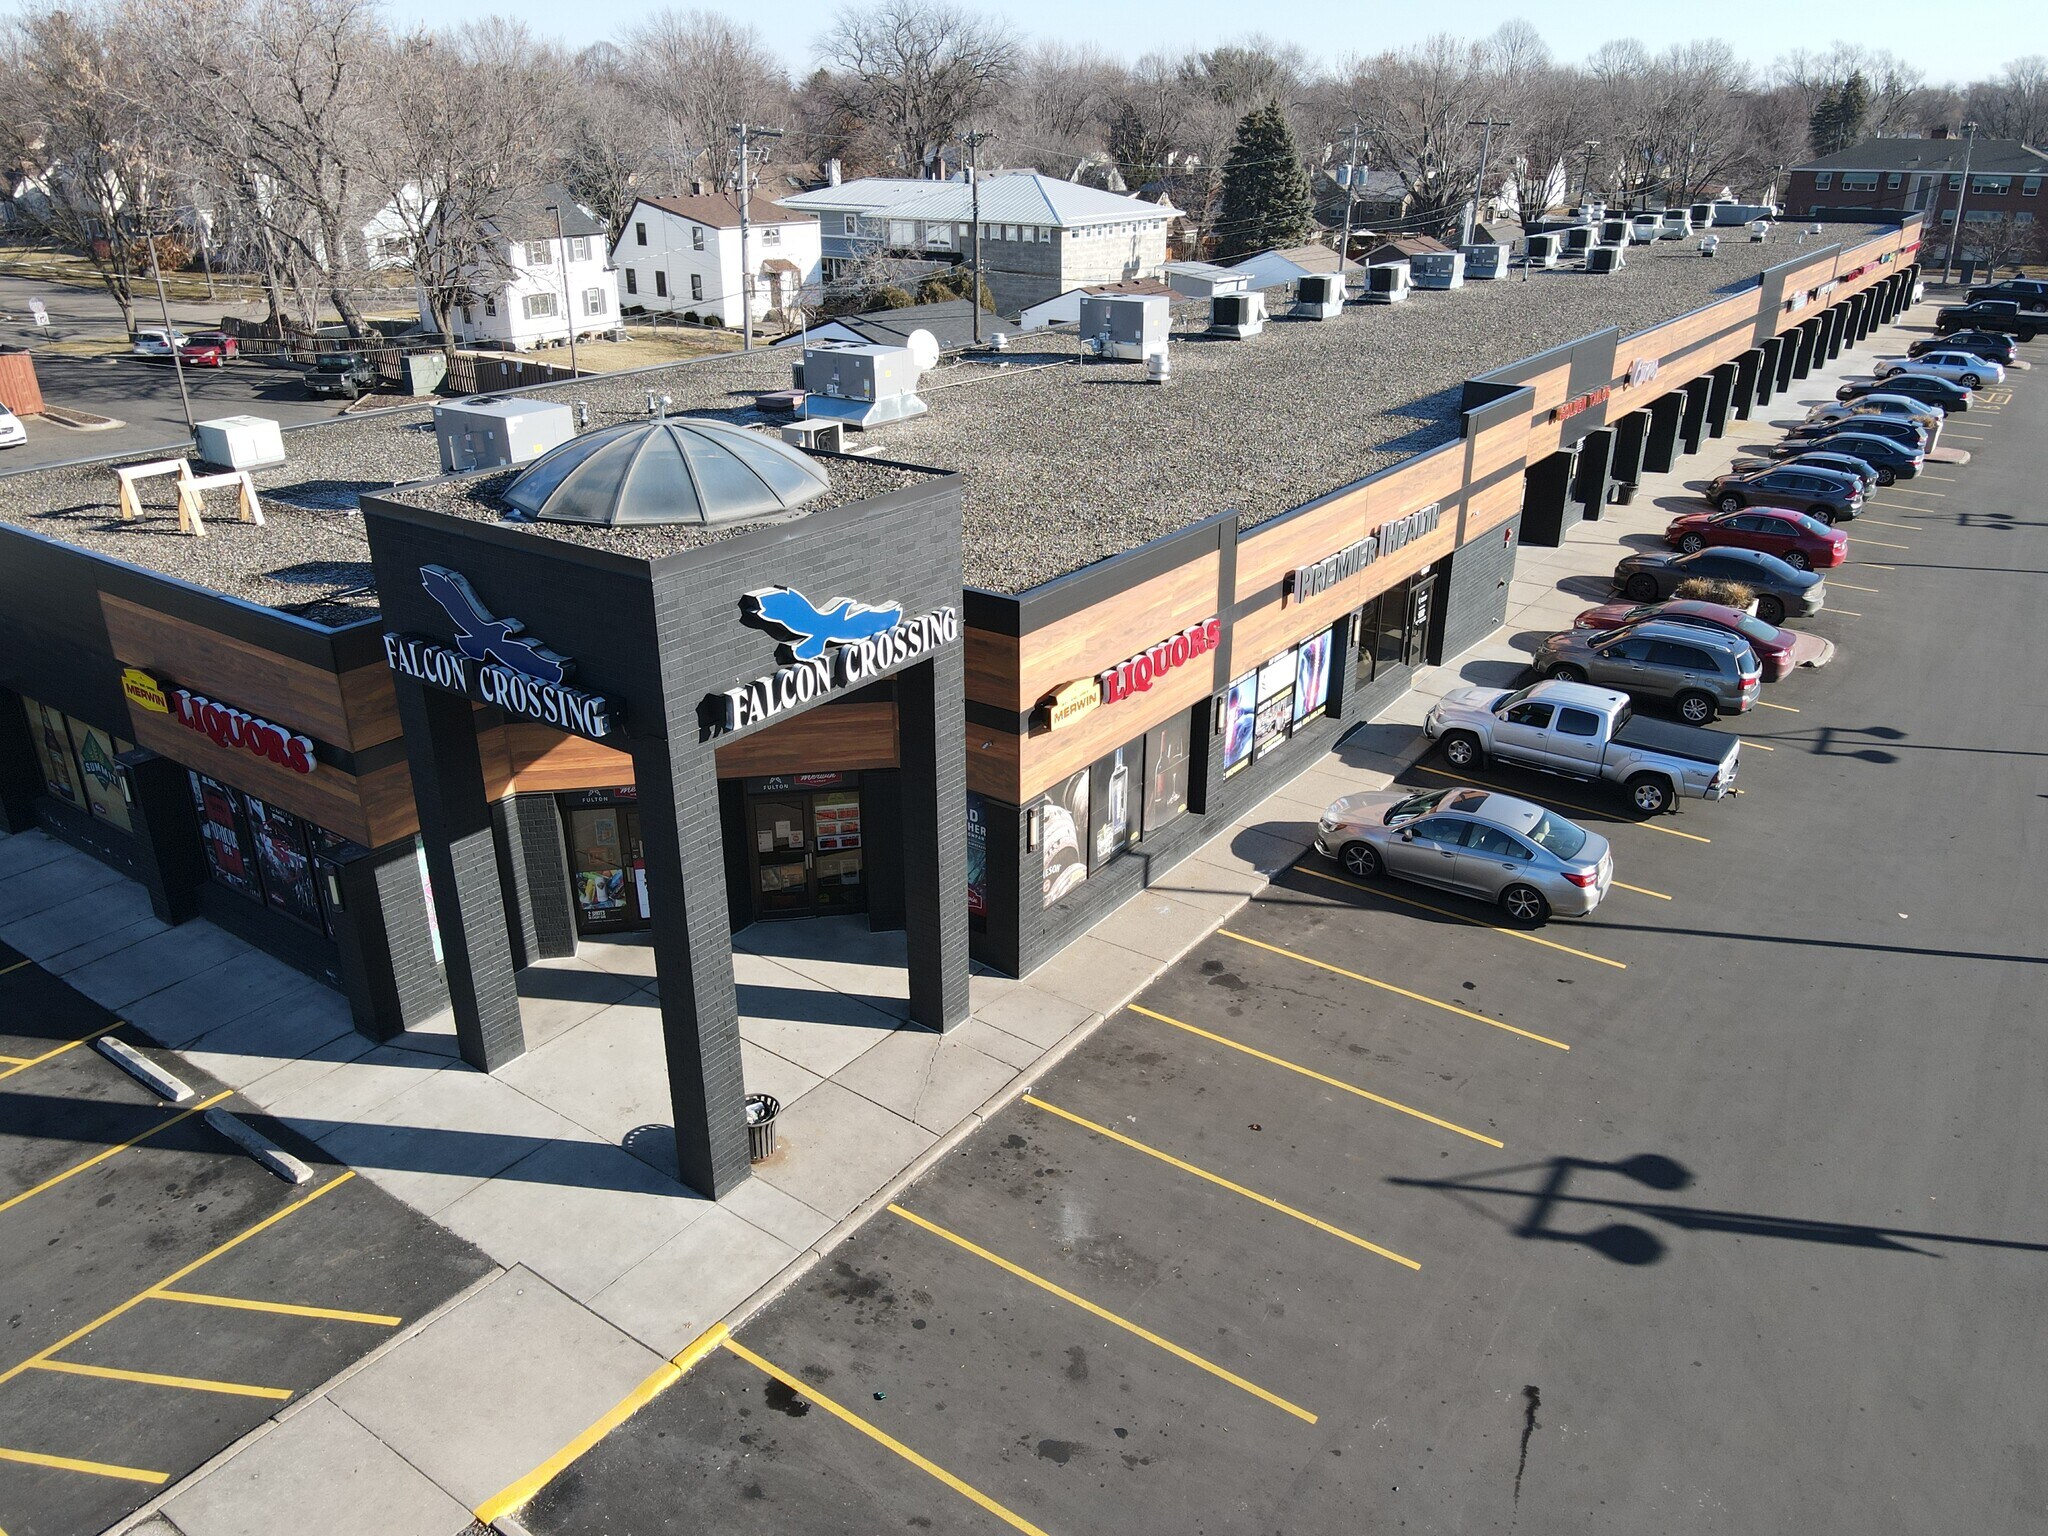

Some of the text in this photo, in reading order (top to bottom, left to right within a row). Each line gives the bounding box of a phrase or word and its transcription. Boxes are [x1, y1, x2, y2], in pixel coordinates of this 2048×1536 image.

[1295, 503, 1440, 603] PREMIER HEALTH
[125, 683, 166, 708] MERWIN
[383, 633, 607, 738] FALCON CROSSING
[728, 606, 959, 731] FALCON CROSSING
[1104, 618, 1221, 704] LIQUORS
[171, 690, 314, 774] LIQUORS
[1053, 692, 1097, 724] MERWIN
[85, 762, 117, 785] SUMMIT
